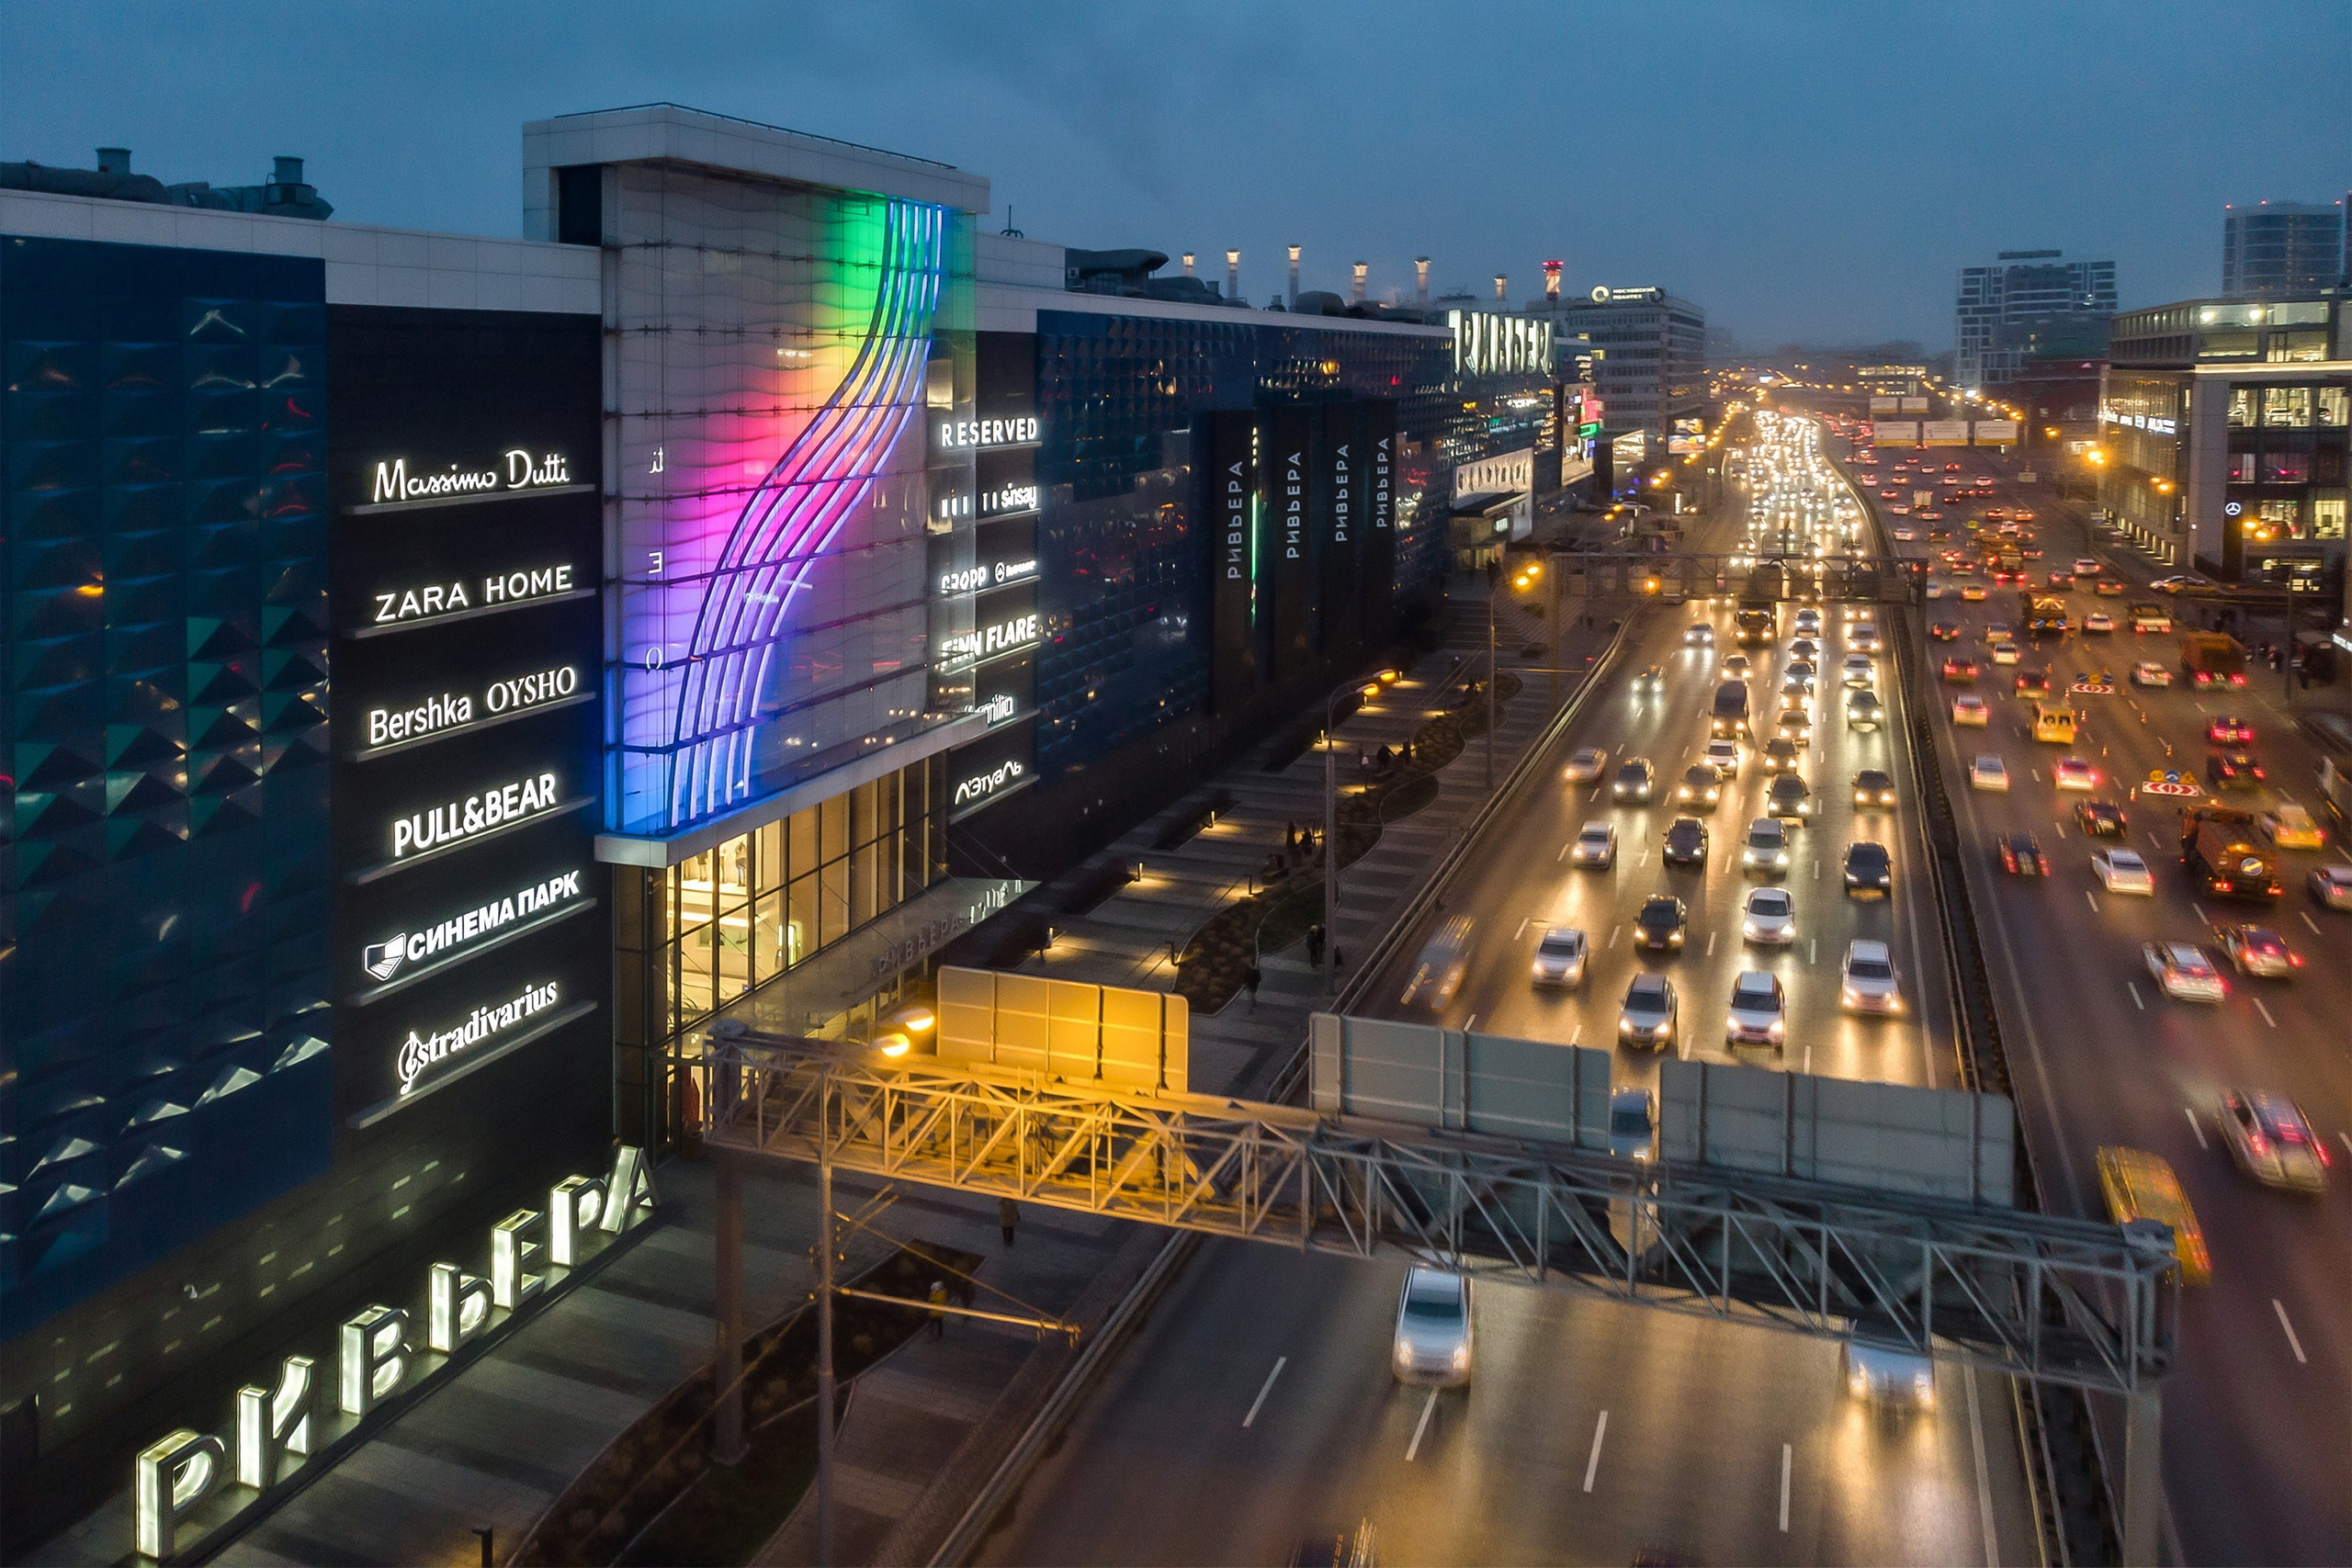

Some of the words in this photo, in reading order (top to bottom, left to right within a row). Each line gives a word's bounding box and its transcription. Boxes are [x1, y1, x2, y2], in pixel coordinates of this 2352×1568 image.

[941, 417, 1037, 447] RESERVED
[373, 458, 497, 502] Massimo
[504, 449, 571, 489] Dutti
[1001, 481, 1037, 510] sinsay
[1286, 452, 1301, 559] РИВЬЕРА
[1335, 444, 1349, 542] РИВЬЕРА
[1376, 437, 1389, 528] РИВЬЕРА
[1227, 461, 1243, 580] РИВЬЕРА
[375, 581, 469, 623] ZARA
[486, 564, 573, 603] HOME
[985, 614, 1037, 653] FLARE
[369, 693, 472, 745] Bershka
[486, 666, 576, 712] OYSHO
[392, 773, 557, 858] PULL&BEAR
[405, 896, 516, 962] СИНЕМА
[516, 869, 582, 917] ПАРК
[135, 1145, 657, 1560] РИВЬЕРА
